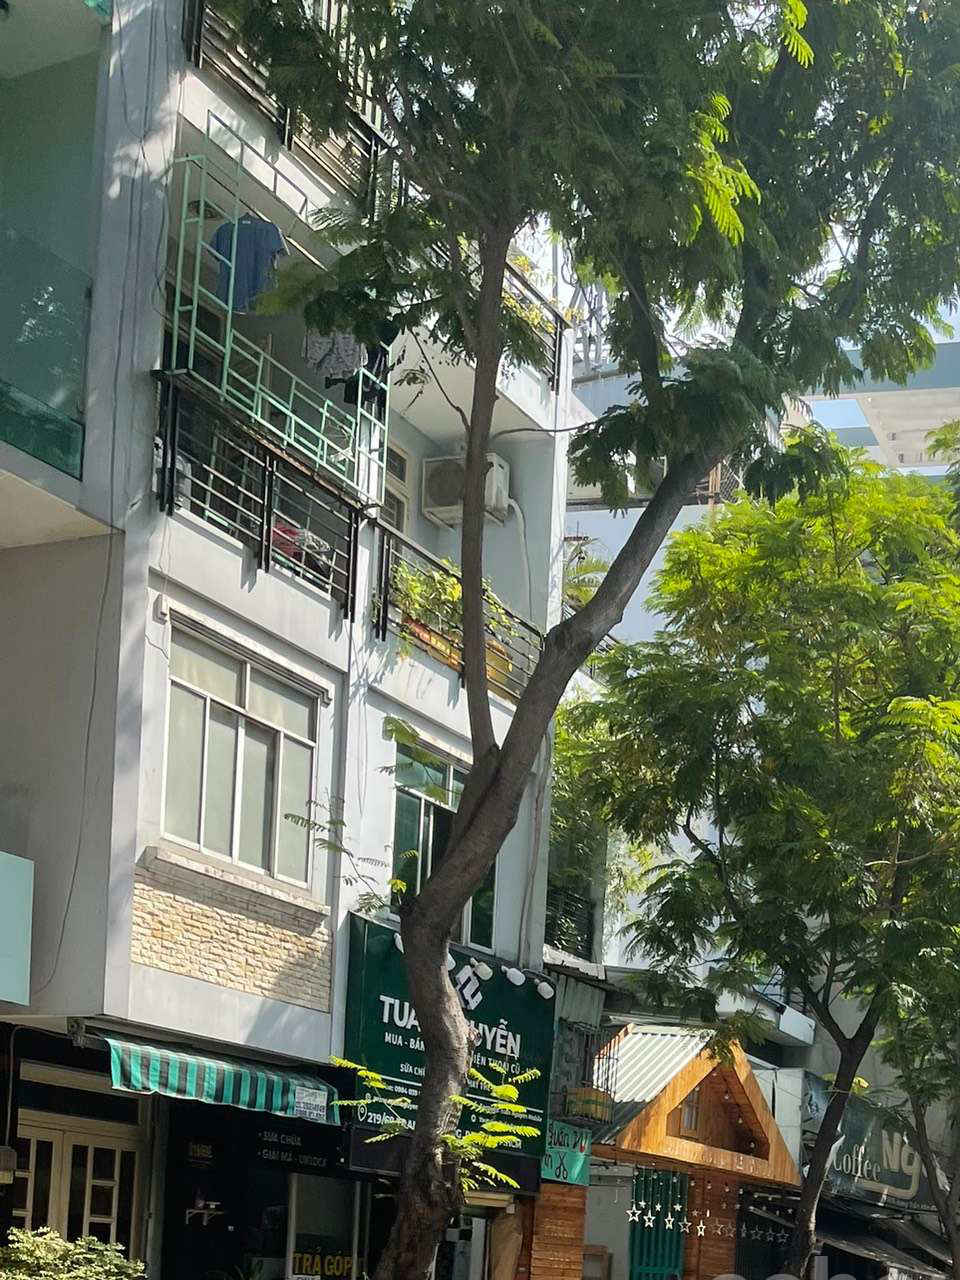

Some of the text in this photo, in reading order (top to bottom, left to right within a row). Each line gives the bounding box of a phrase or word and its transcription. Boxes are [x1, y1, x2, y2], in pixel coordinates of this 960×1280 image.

[379, 994, 521, 1061] TUA UYỄN
[384, 1032, 403, 1047] MUA
